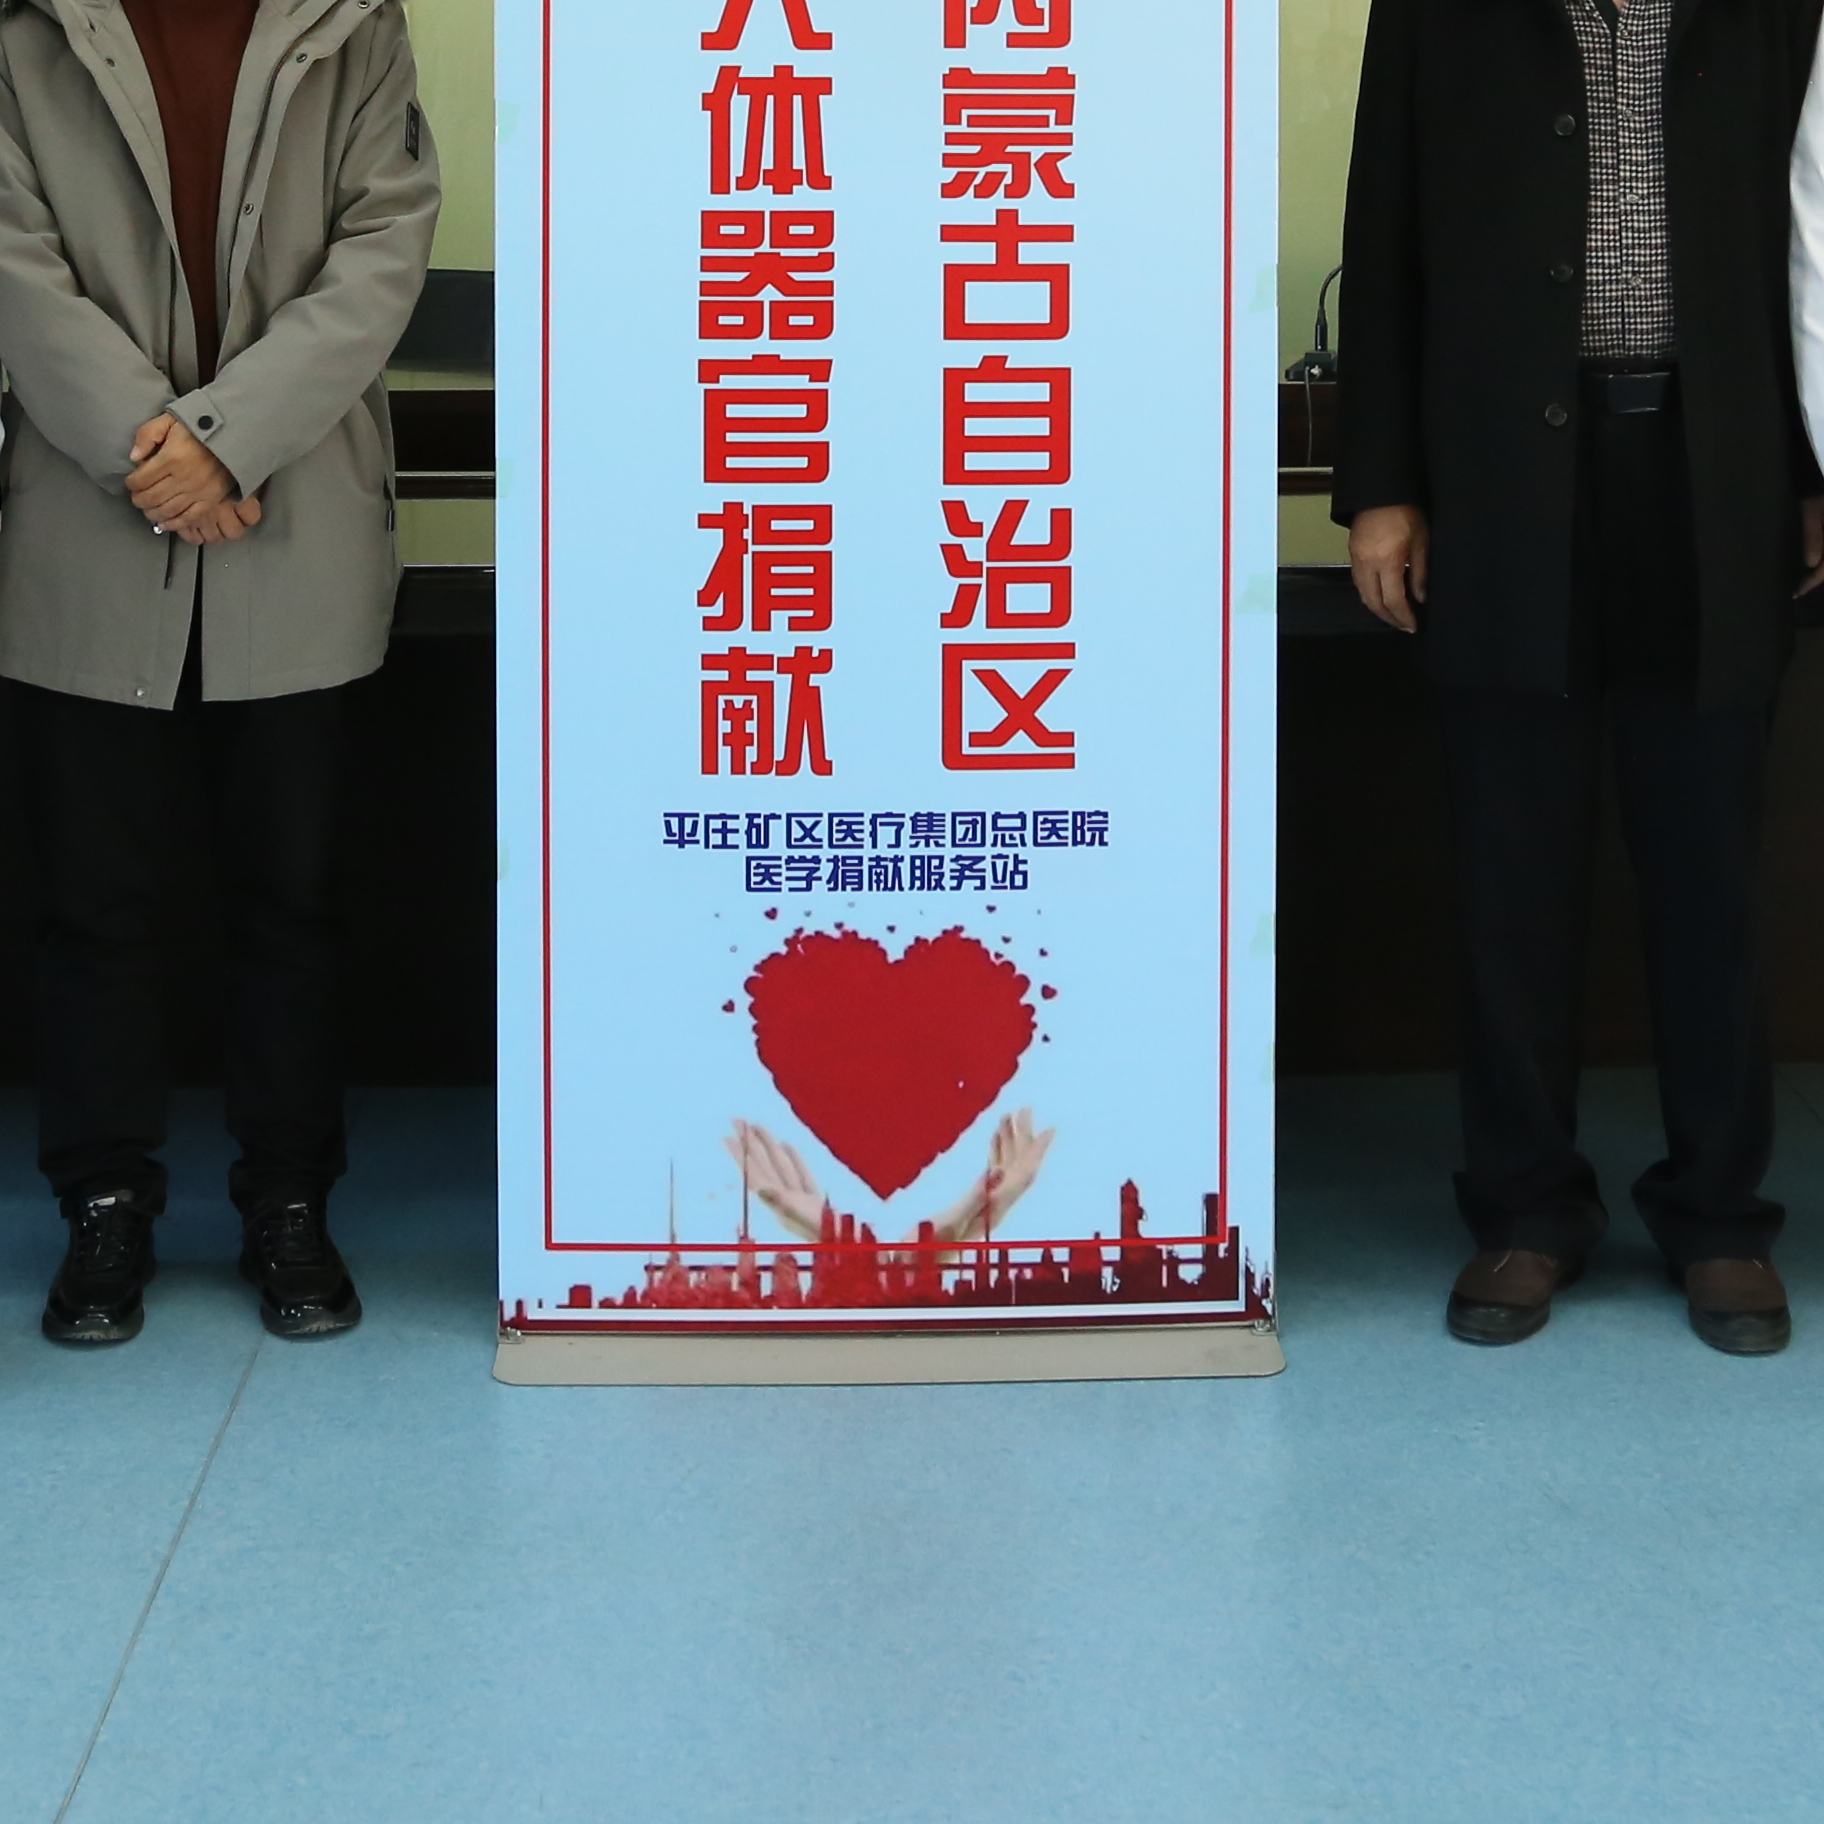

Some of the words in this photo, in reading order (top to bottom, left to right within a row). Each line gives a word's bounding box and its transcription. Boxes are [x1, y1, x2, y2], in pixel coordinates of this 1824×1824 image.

[661, 809, 1110, 850] 平庄矿区医疗集团总医院
[744, 852, 1030, 893] 医学捐献服务站
